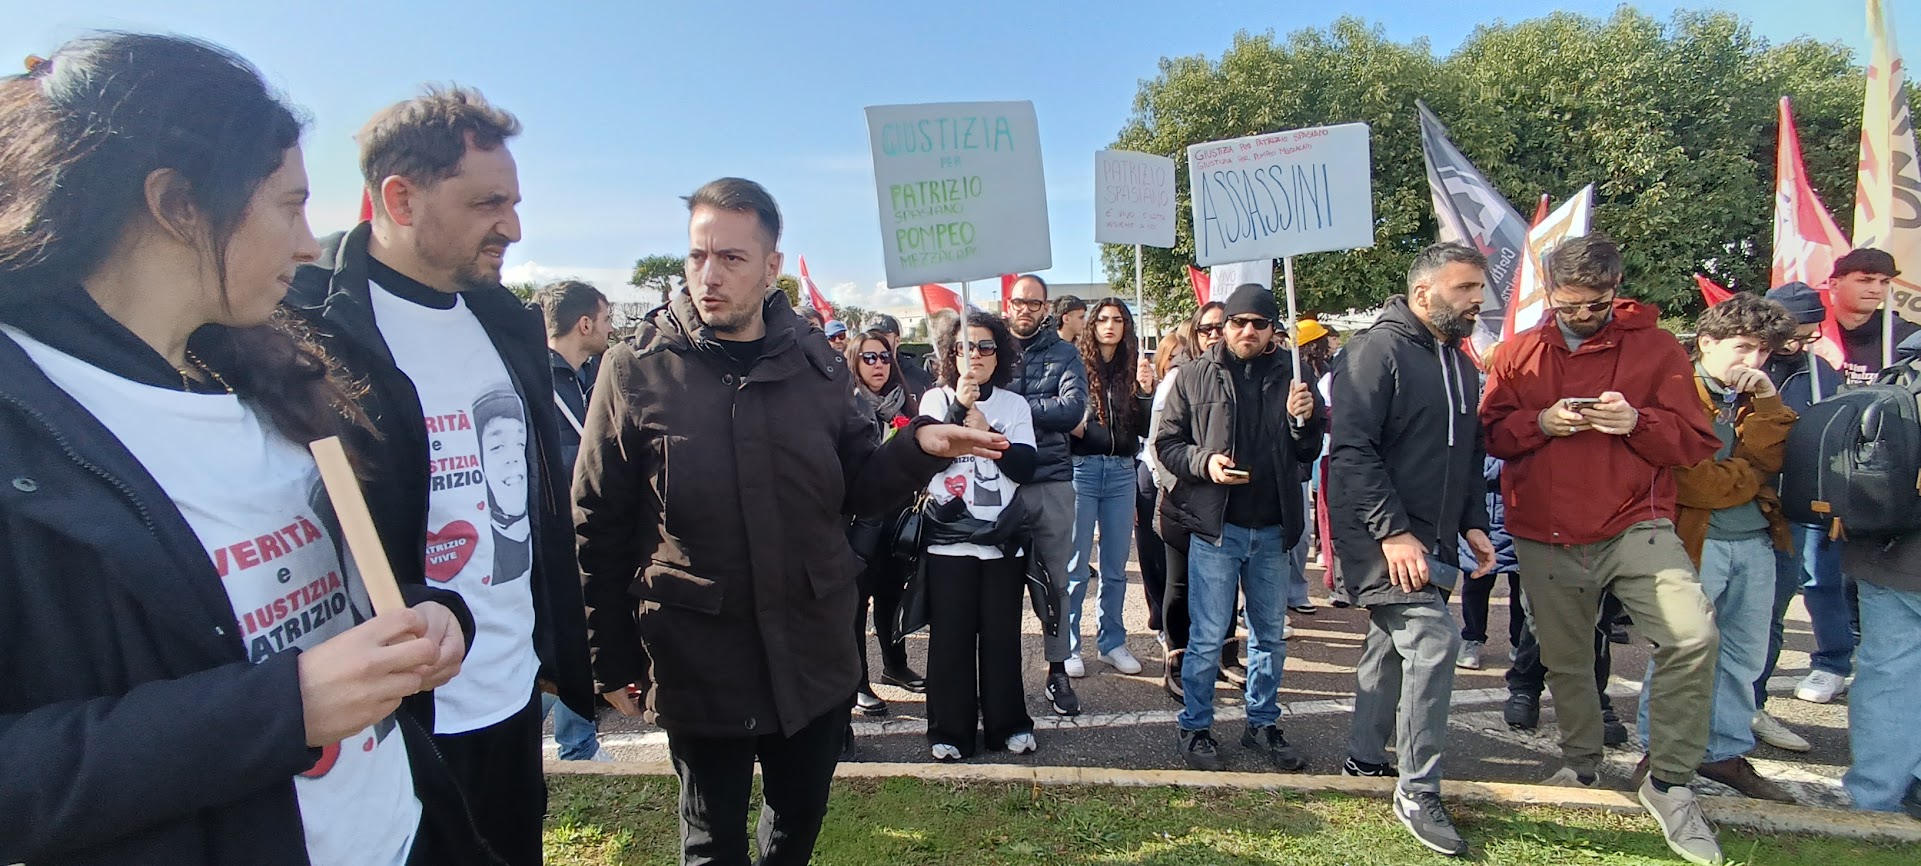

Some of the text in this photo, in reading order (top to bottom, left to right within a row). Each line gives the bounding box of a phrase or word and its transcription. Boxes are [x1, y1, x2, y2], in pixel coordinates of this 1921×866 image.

[882, 116, 1014, 157] GIUSTIZIA
[940, 156, 961, 168] PER
[1104, 160, 1166, 187] PATRIZIO
[889, 176, 982, 211] PATRIZIO
[1104, 185, 1169, 207] SPASIANO
[894, 203, 964, 224] SPASIANO
[1202, 163, 1332, 257] ASSASSINI
[896, 221, 975, 253] POMPEO
[1213, 283, 1235, 297] LOTT
[424, 410, 472, 434] RITÀ
[432, 440, 442, 451] e
[429, 454, 479, 474] STIZIA
[431, 469, 484, 492] RIZIO
[425, 537, 467, 555] TRIZIO
[429, 551, 458, 565] VIVE
[277, 567, 291, 584] e
[238, 571, 341, 638] IUSTIZIA
[250, 592, 346, 663] ATRIZIO
